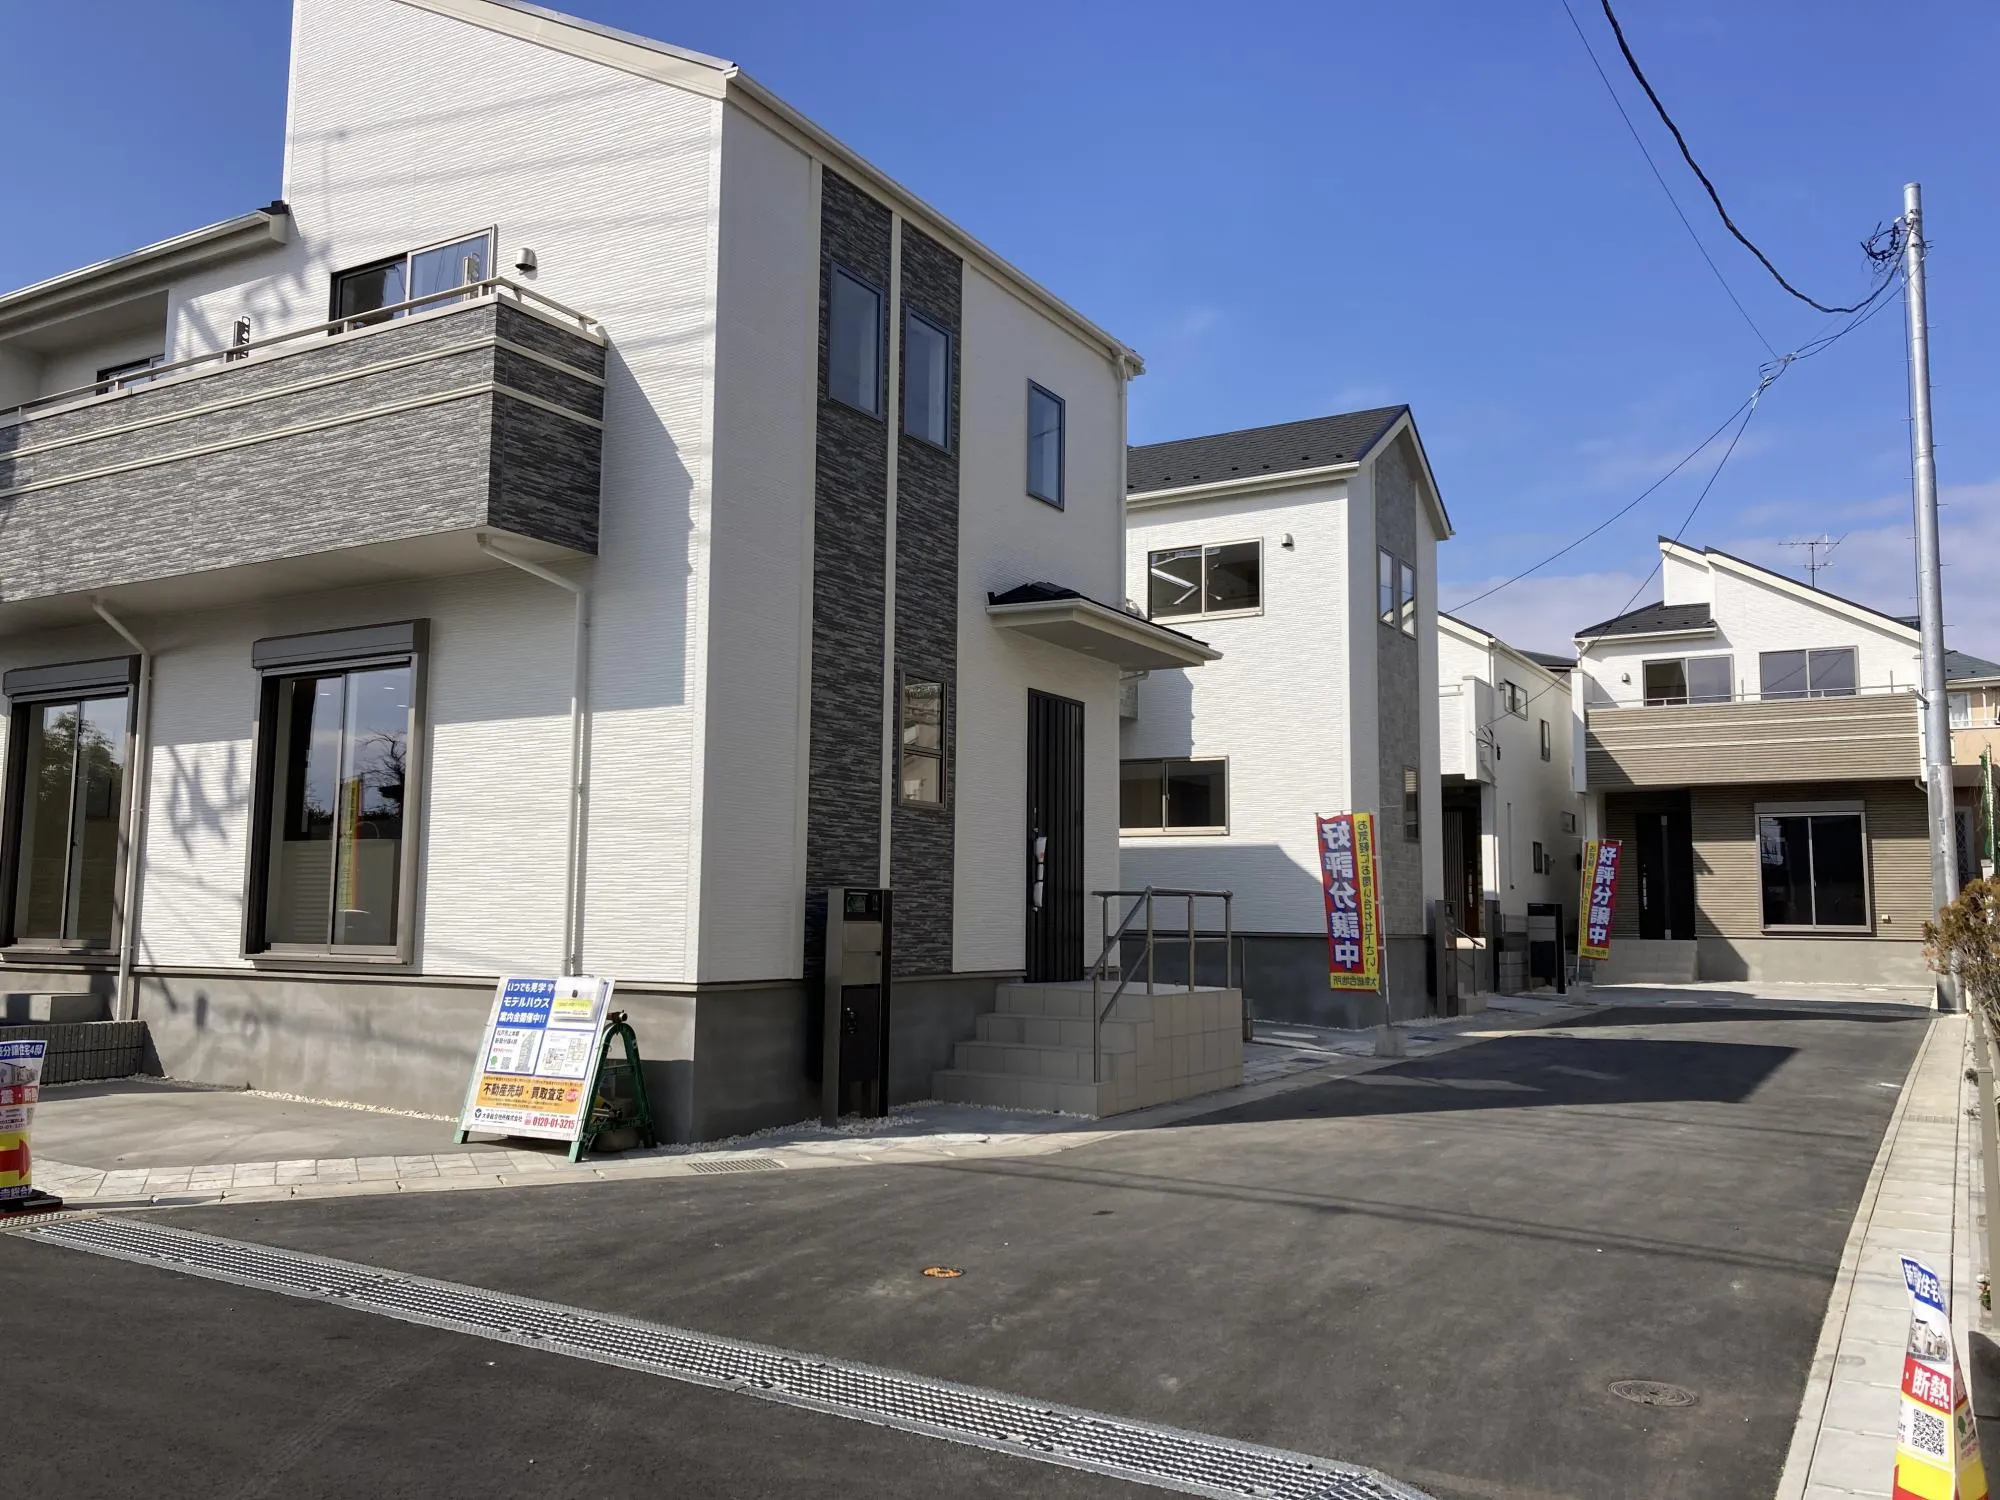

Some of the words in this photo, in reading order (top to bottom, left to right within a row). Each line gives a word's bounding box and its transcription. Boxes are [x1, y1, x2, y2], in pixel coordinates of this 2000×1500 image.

[1589, 845, 1617, 945] 好評分譲中
[503, 996, 550, 1009] モデルハウス
[532, 1116, 575, 1130] 0120-01-3215
